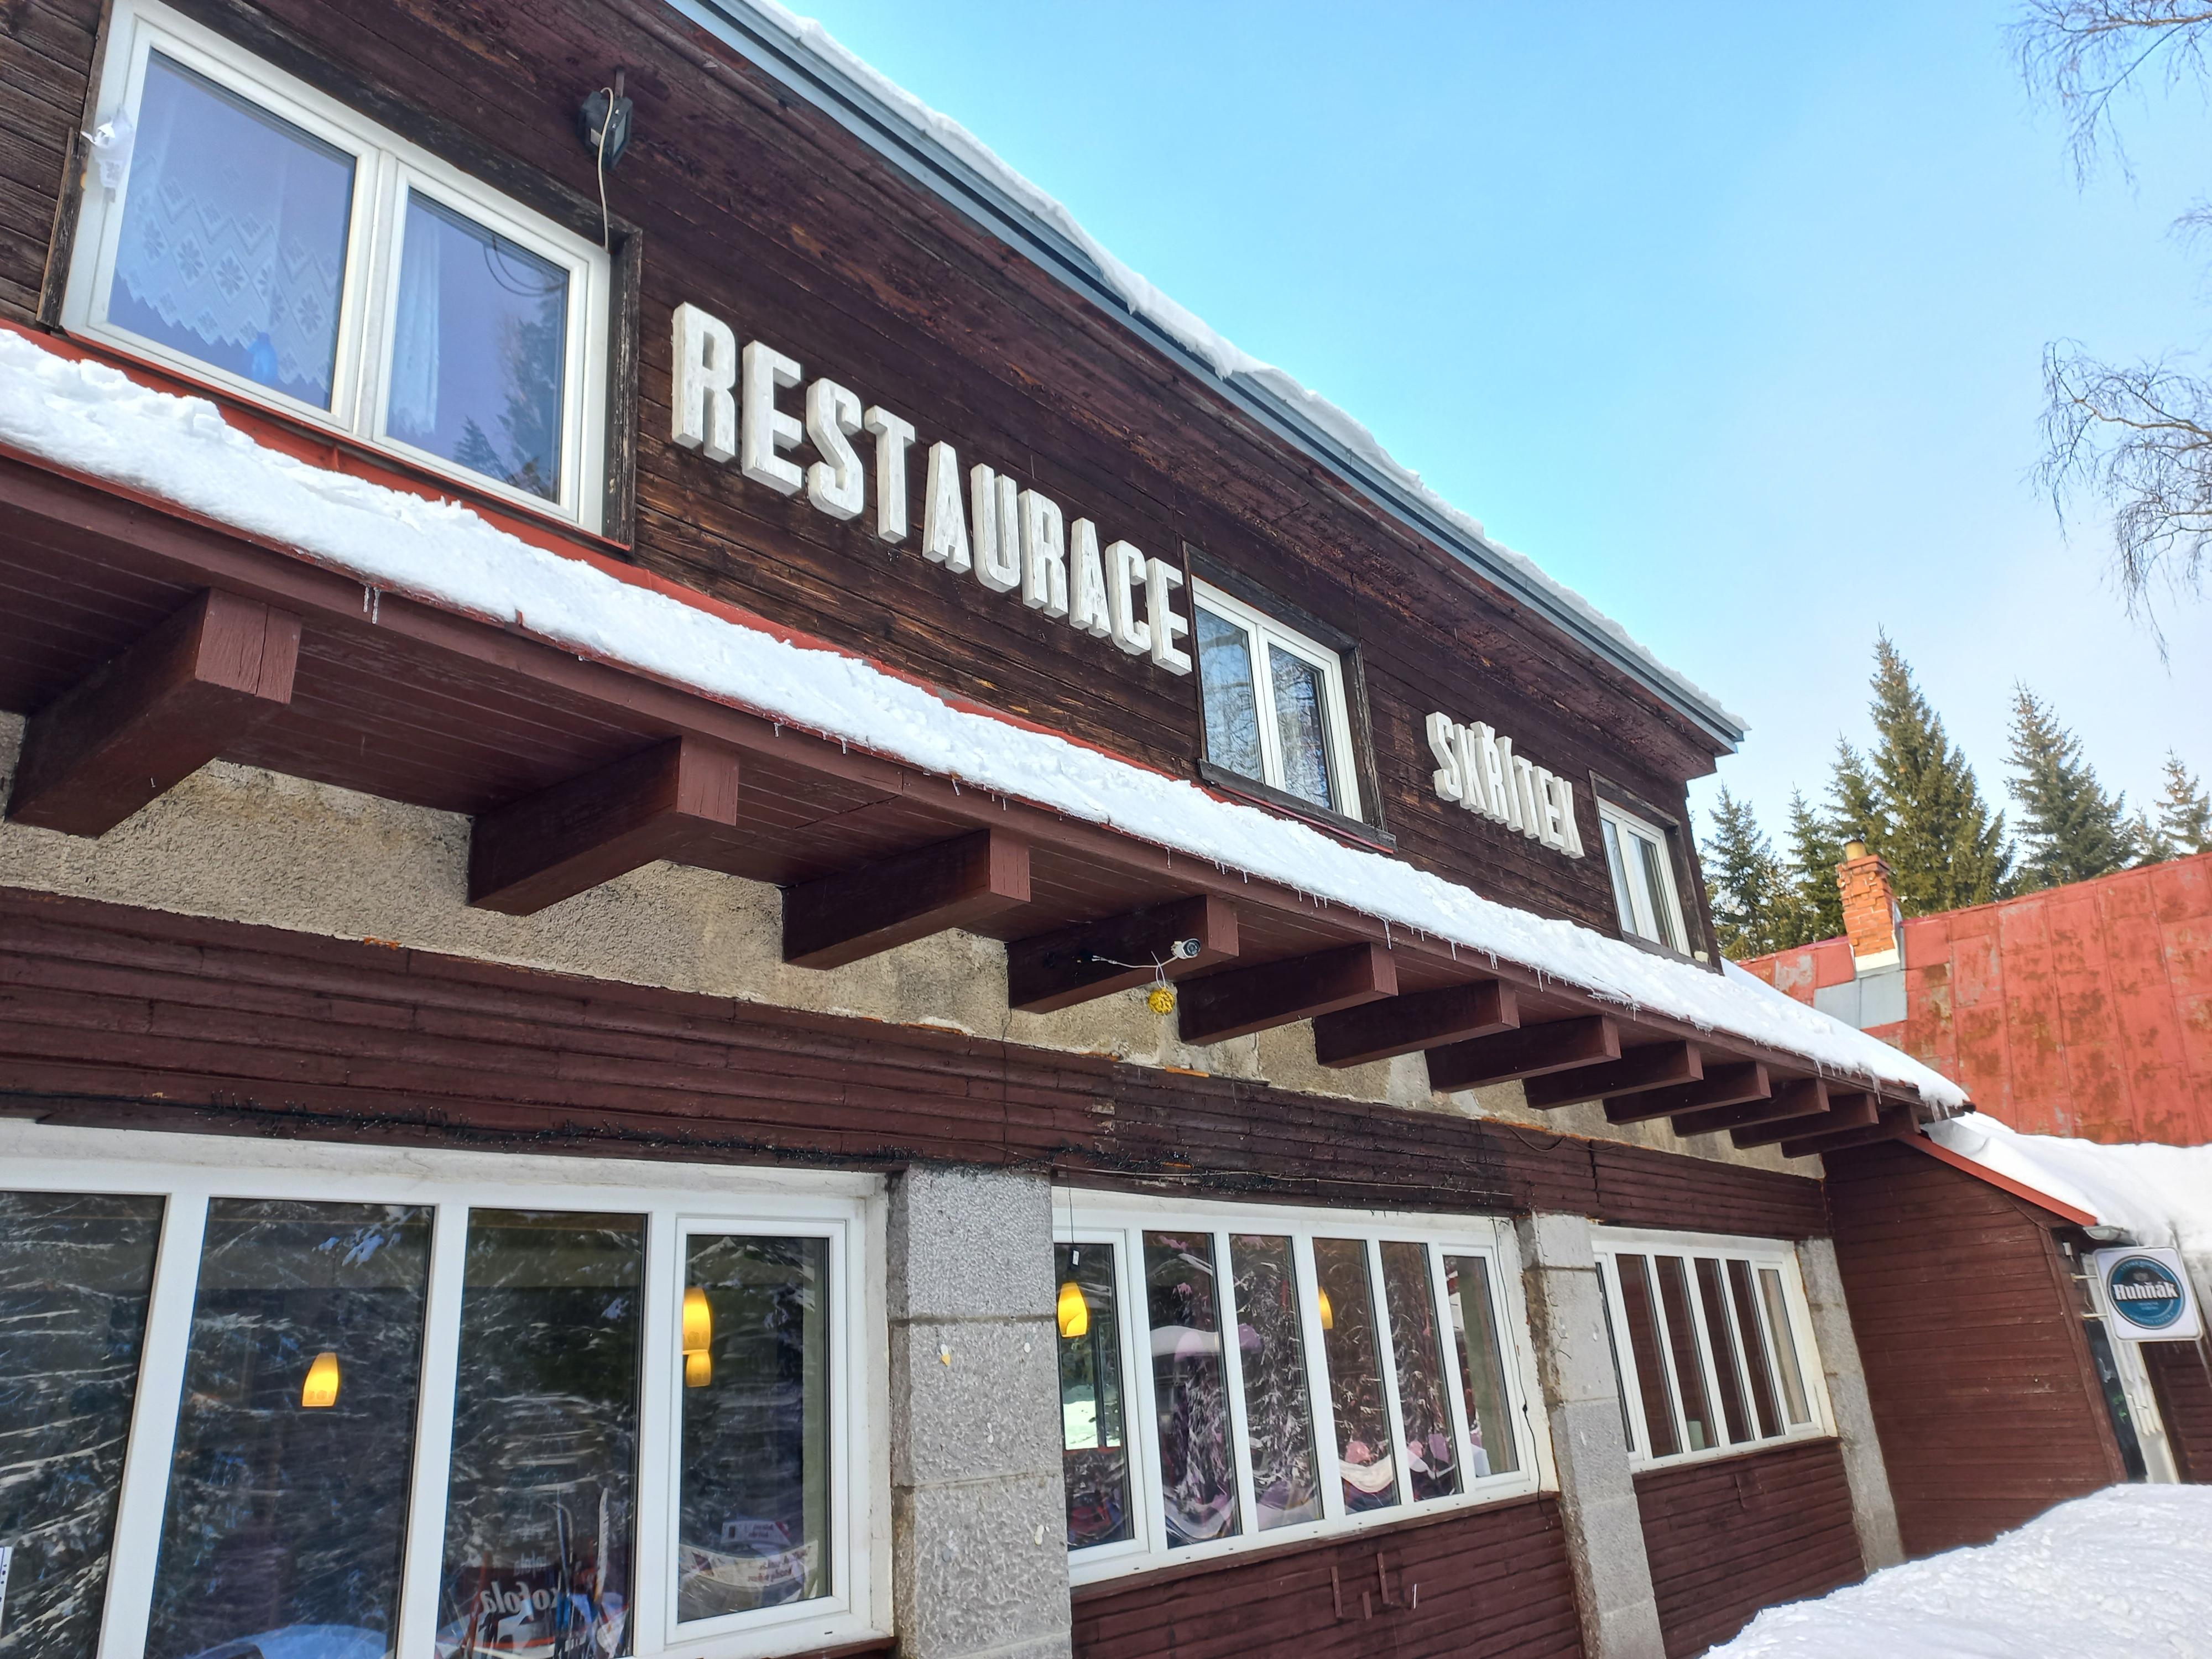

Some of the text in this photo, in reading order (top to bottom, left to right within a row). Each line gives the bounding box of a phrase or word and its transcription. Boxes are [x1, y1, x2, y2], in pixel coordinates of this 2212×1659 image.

[671, 301, 1192, 676] RESTAURACE
[1425, 711, 1585, 859] SKŘÍTEK
[2112, 1281, 2178, 1300] Huhňák
